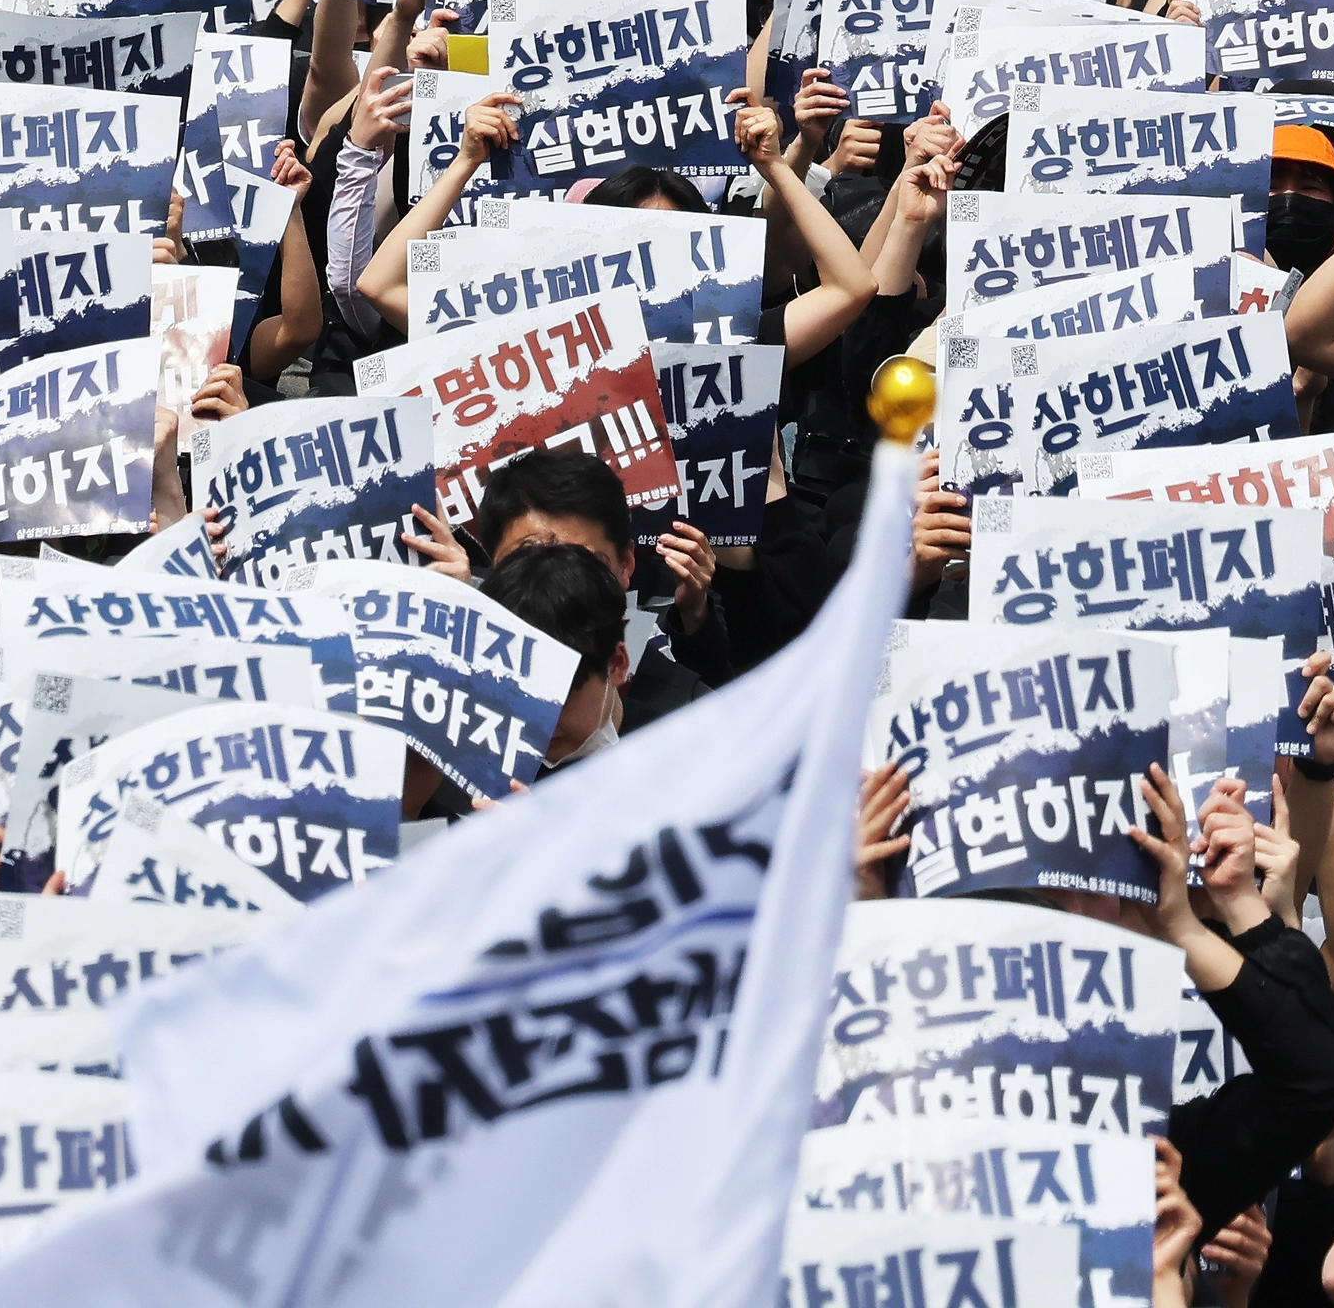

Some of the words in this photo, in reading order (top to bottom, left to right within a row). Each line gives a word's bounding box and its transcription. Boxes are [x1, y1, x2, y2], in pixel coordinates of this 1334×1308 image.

[505, 1, 712, 90] 상한폐지
[525, 84, 731, 174] 실현하자
[699, 165, 747, 176] 공동투쟁본부
[1025, 104, 1238, 182] 상한폐지
[965, 206, 1193, 297] 상한폐지
[435, 304, 614, 428] 명하게
[1031, 325, 1253, 453] 상한폐지
[205, 408, 403, 536] 상한폐지
[709, 535, 757, 546] 공동투쟁본부
[993, 519, 1279, 626] 상한폐지
[355, 664, 529, 778] 현하자
[885, 648, 1135, 783] 상한폐지
[908, 772, 1155, 897] 실현하자
[831, 941, 1137, 1047] 상한폐지
